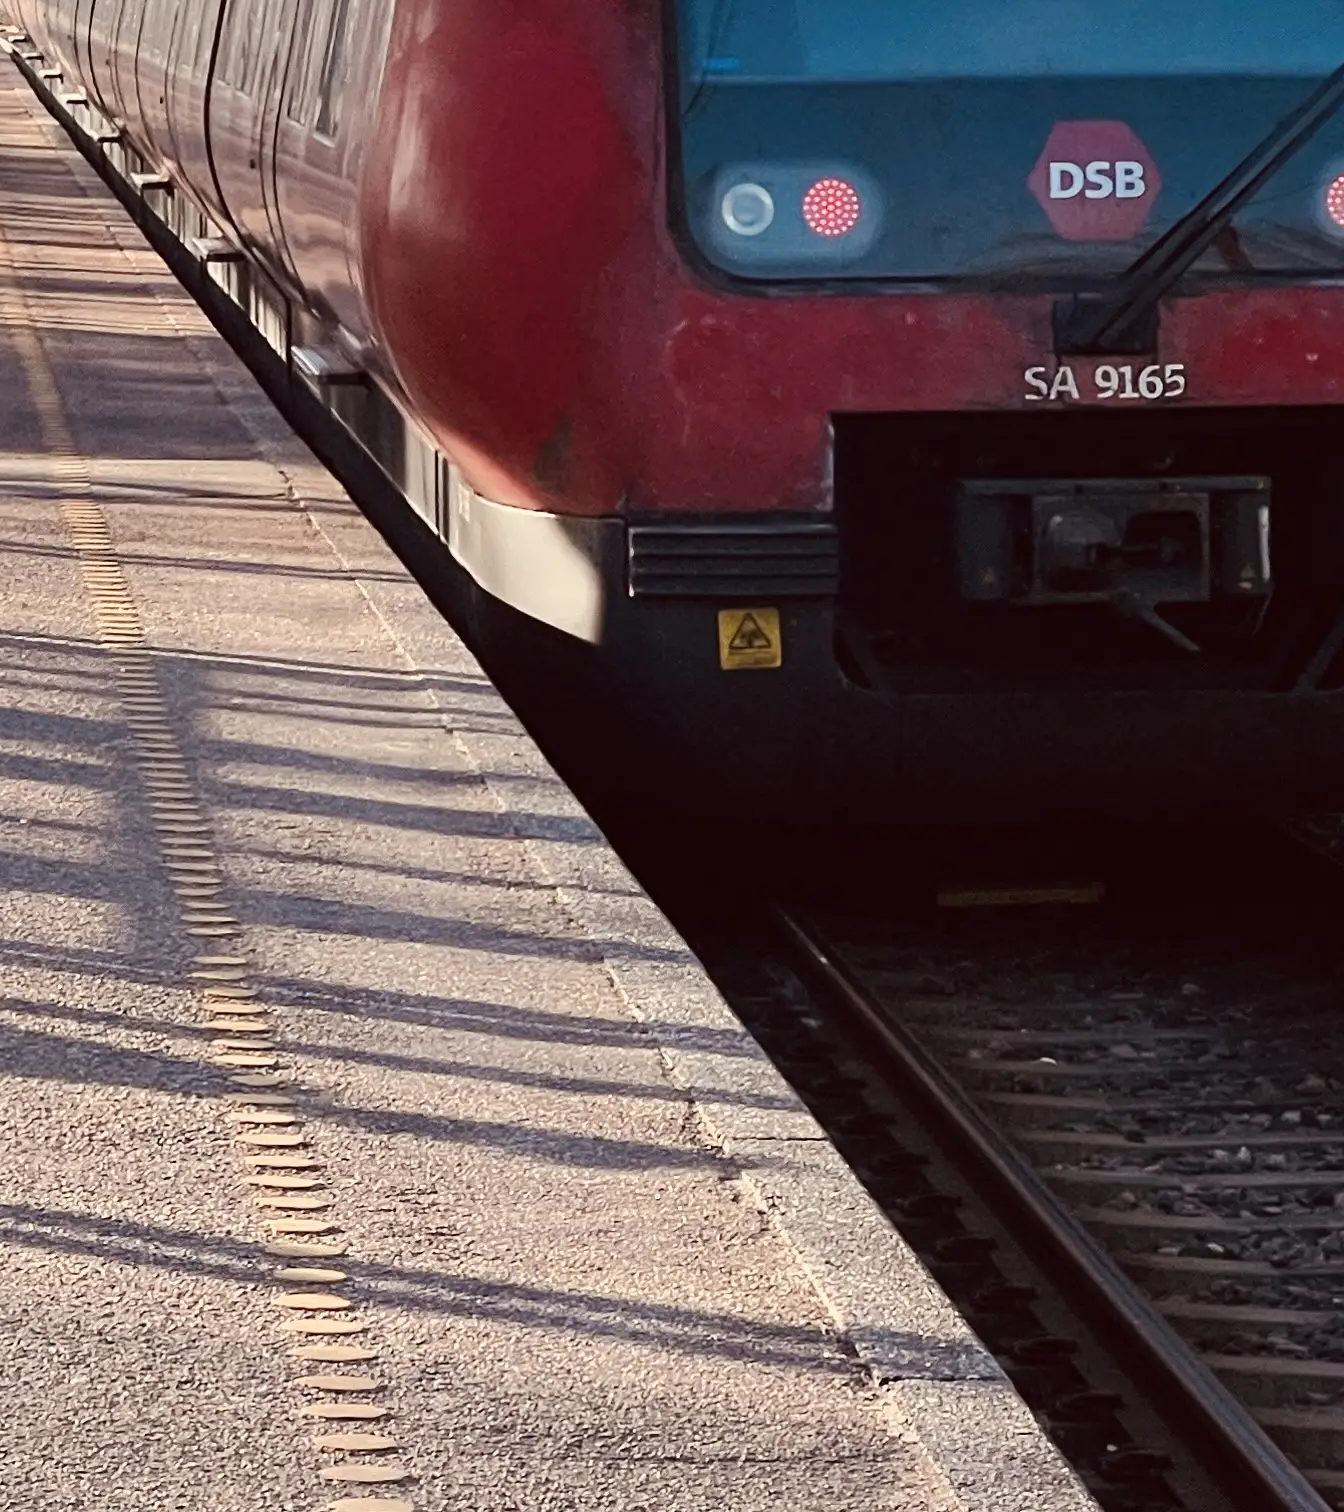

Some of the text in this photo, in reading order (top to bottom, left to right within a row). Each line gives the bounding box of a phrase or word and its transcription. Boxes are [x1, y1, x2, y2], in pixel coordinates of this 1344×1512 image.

[1049, 161, 1146, 199] DSB
[1024, 364, 1187, 401] SA 9165
